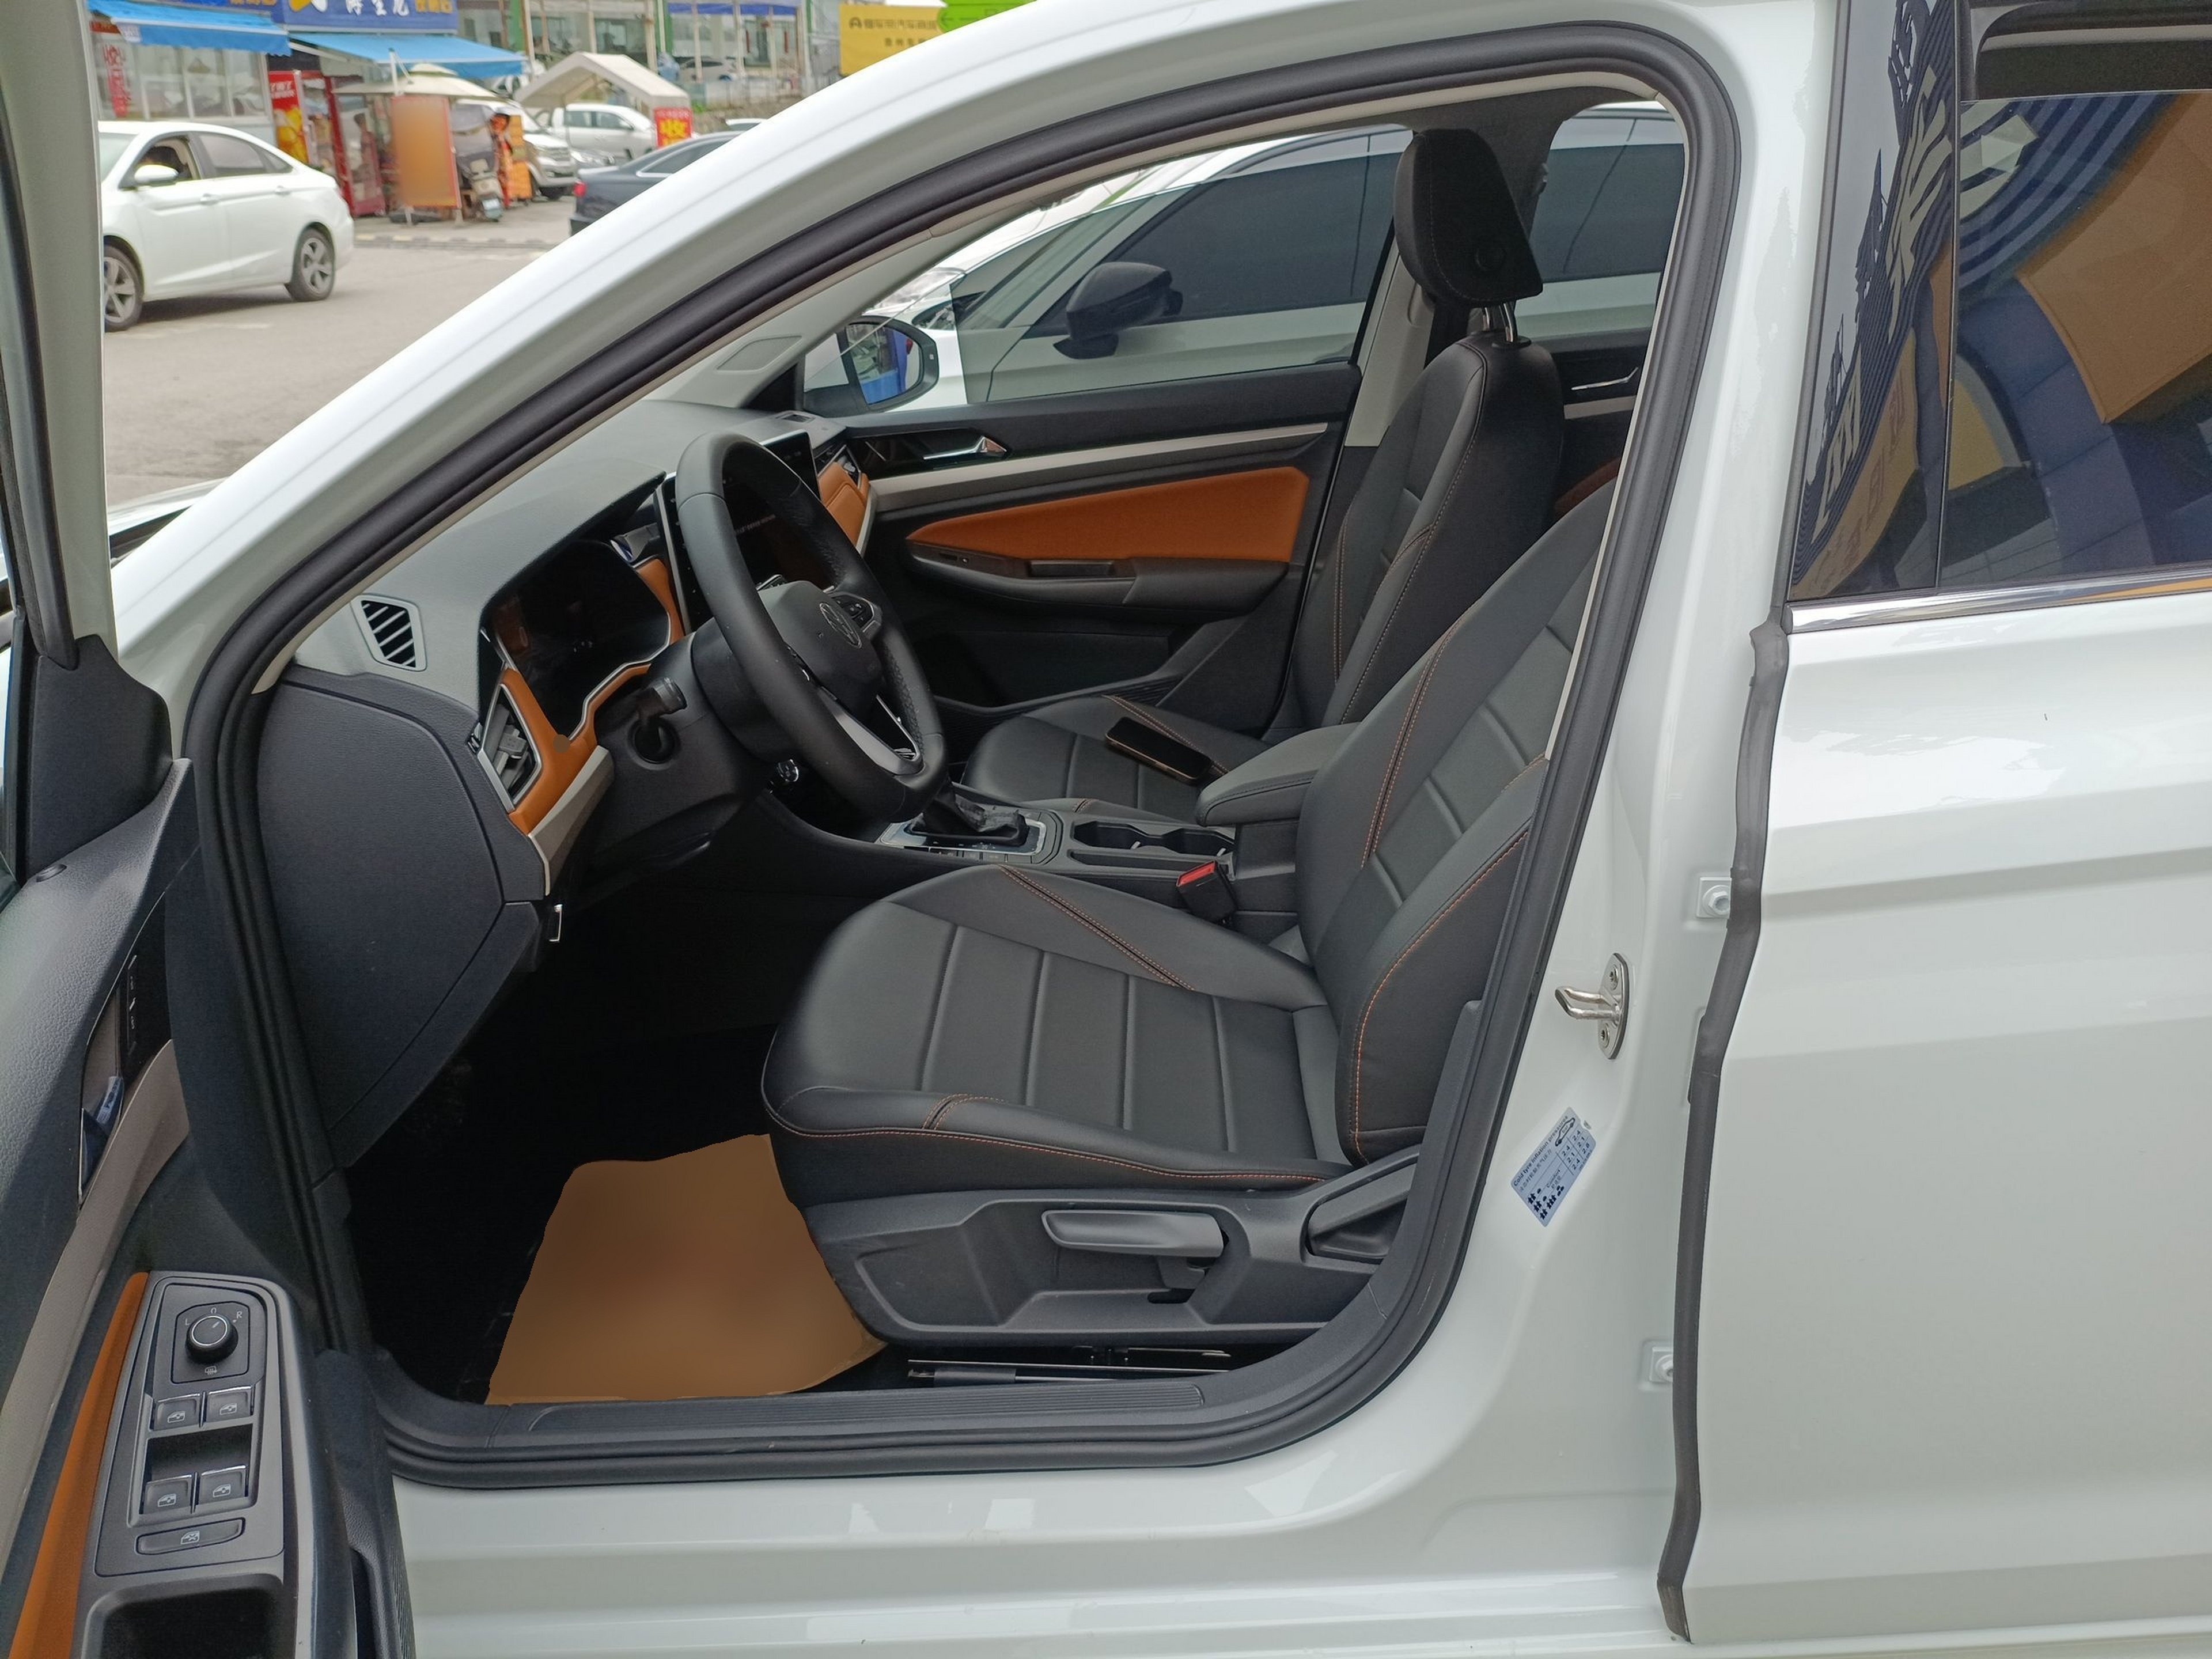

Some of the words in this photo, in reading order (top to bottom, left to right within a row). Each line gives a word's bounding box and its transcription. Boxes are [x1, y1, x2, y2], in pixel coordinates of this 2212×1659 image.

[1513, 1173, 1524, 1186] Cold
[1523, 1162, 1532, 1174] tyre
[1531, 1141, 1548, 1163] inflation
[1548, 1116, 1568, 1142] pressures
[1562, 1145, 1570, 1156] 2.4
[1572, 1130, 1581, 1141] 2.4
[1567, 1152, 1575, 1163] 2.1
[1572, 1158, 1580, 1170] 2.4
